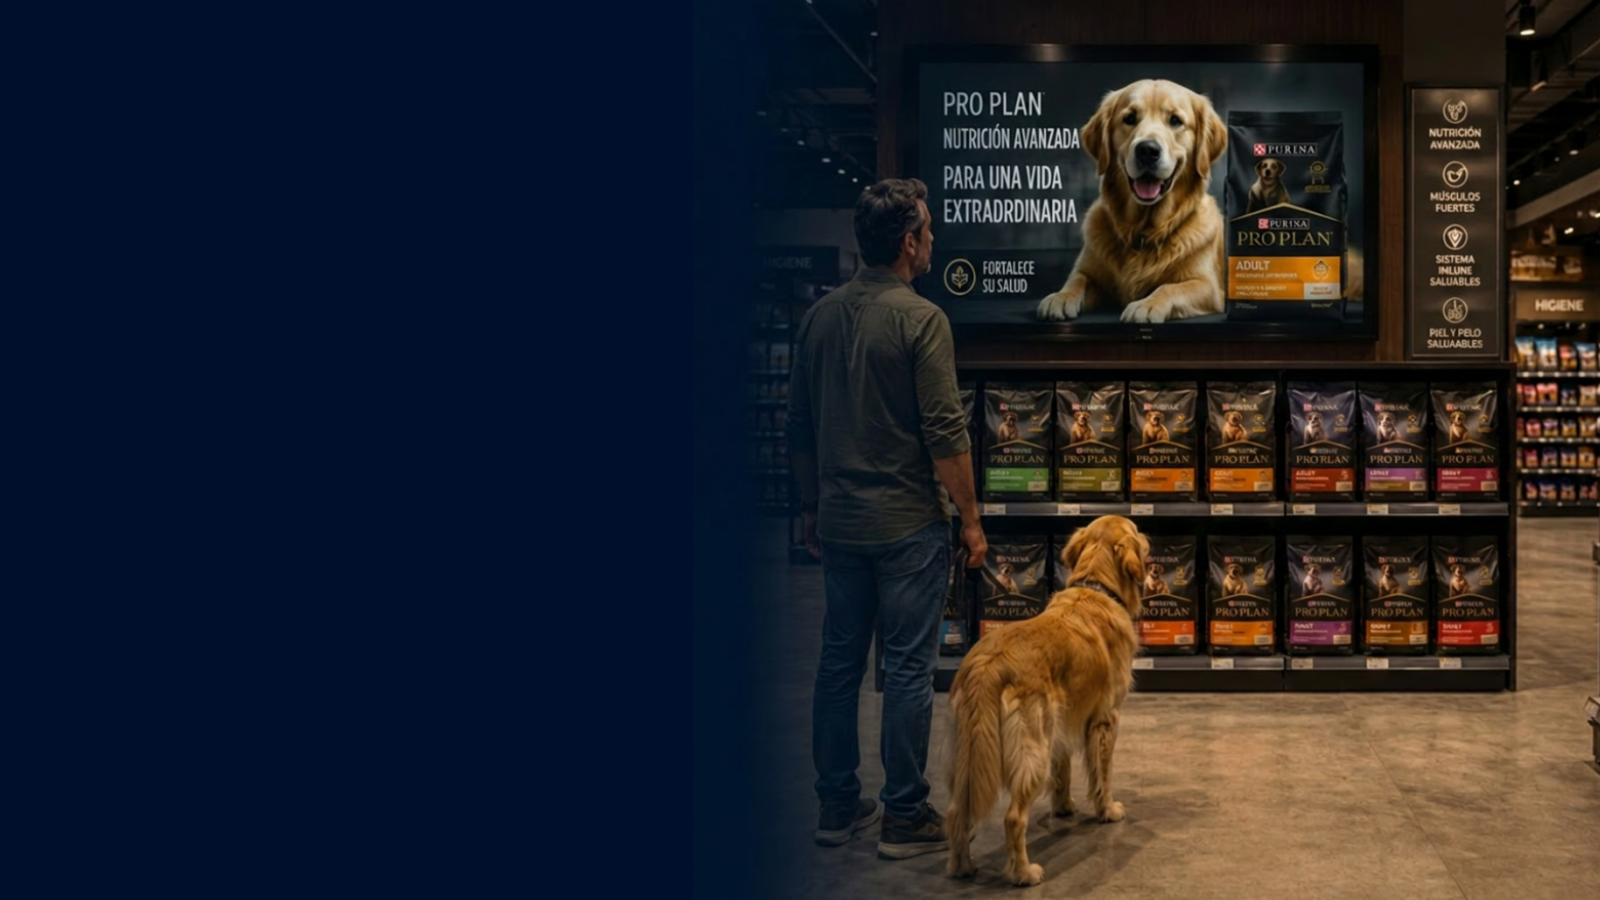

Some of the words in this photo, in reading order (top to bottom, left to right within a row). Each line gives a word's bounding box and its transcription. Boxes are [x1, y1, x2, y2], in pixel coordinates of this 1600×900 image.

[944, 91, 983, 116] PRO
[989, 91, 1042, 116] PLAN
[943, 123, 1010, 149] NUTRICIÓN
[1013, 127, 1080, 149] AVANZADA
[1428, 126, 1482, 137] NUTRICIÓN
[1430, 141, 1481, 150] AVANZADA
[944, 165, 985, 190] PARA
[989, 165, 1022, 190] UNA
[1026, 165, 1062, 190] VIDA
[1435, 203, 1476, 213] FUERTES
[1237, 231, 1276, 246] PRO
[1279, 231, 1331, 246] PLAN
[1435, 254, 1476, 264] SISTEMA
[982, 261, 1035, 275] FORTALECE
[1236, 260, 1270, 271] ADULT
[982, 278, 995, 293] SU
[997, 279, 1028, 293] SALUD
[1429, 276, 1481, 287] SALUABLES
[1535, 299, 1584, 312] HIGIENE
[1429, 328, 1449, 338] PIEL
[1450, 328, 1457, 338] Y
[1458, 328, 1482, 338] PELO
